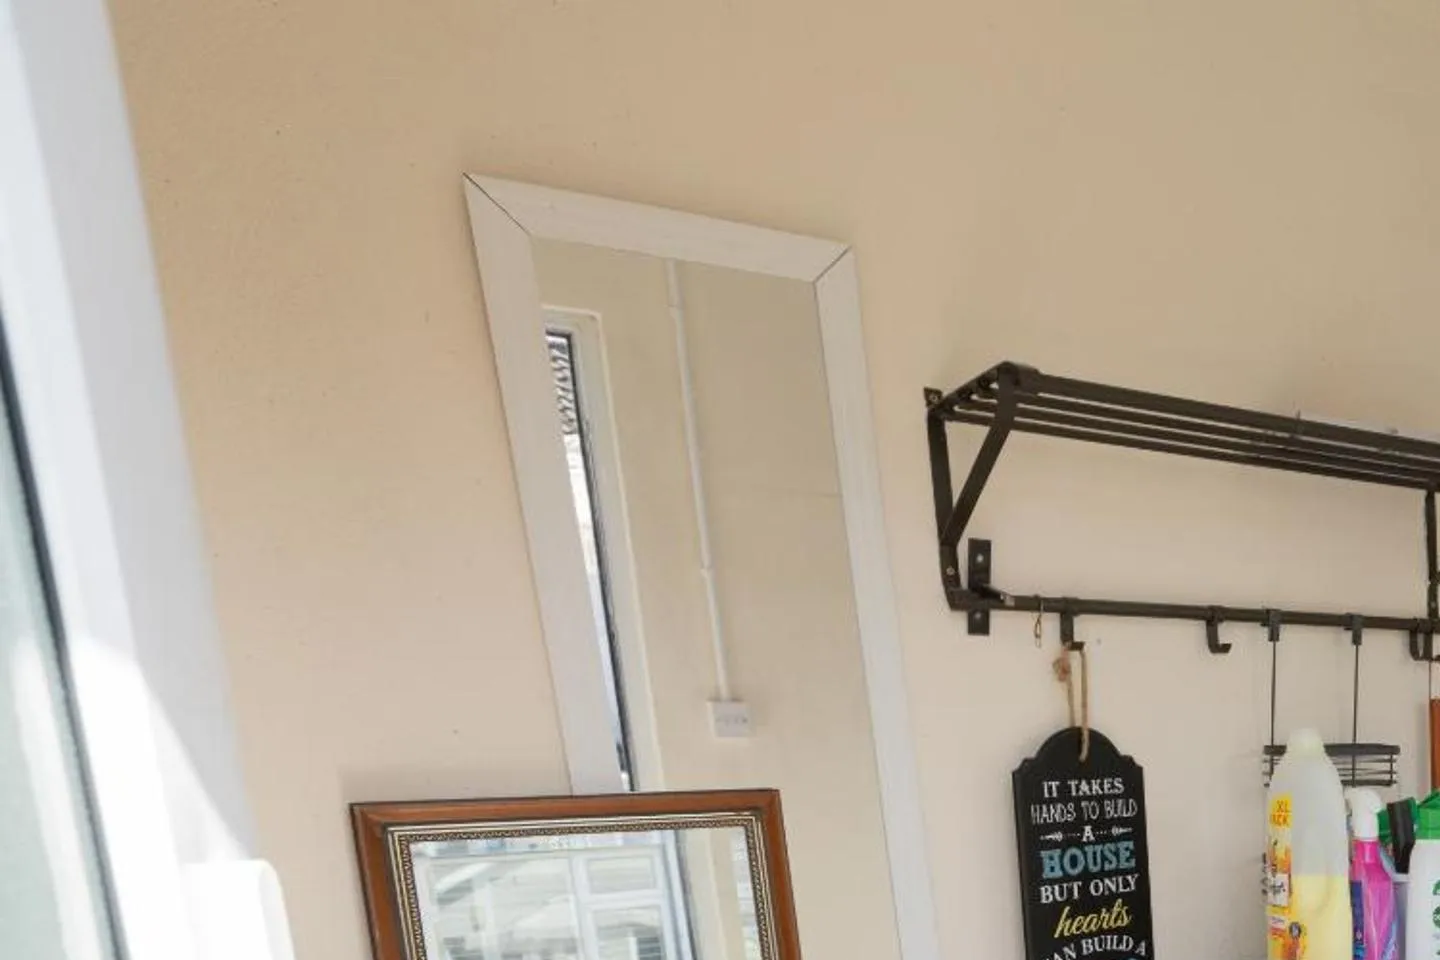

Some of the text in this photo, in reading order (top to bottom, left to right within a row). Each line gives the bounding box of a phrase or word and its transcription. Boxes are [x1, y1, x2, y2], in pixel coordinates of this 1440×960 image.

[1043, 777, 1125, 798] IT TAKES
[1031, 798, 1138, 825] HANDS TO BUILD
[1082, 825, 1095, 843] A
[1040, 840, 1136, 879] HOUSE
[1040, 873, 1141, 904] BUT ONLY
[1054, 899, 1132, 938] hearts
[1081, 934, 1134, 957] BUILD
[1134, 939, 1147, 957] A
